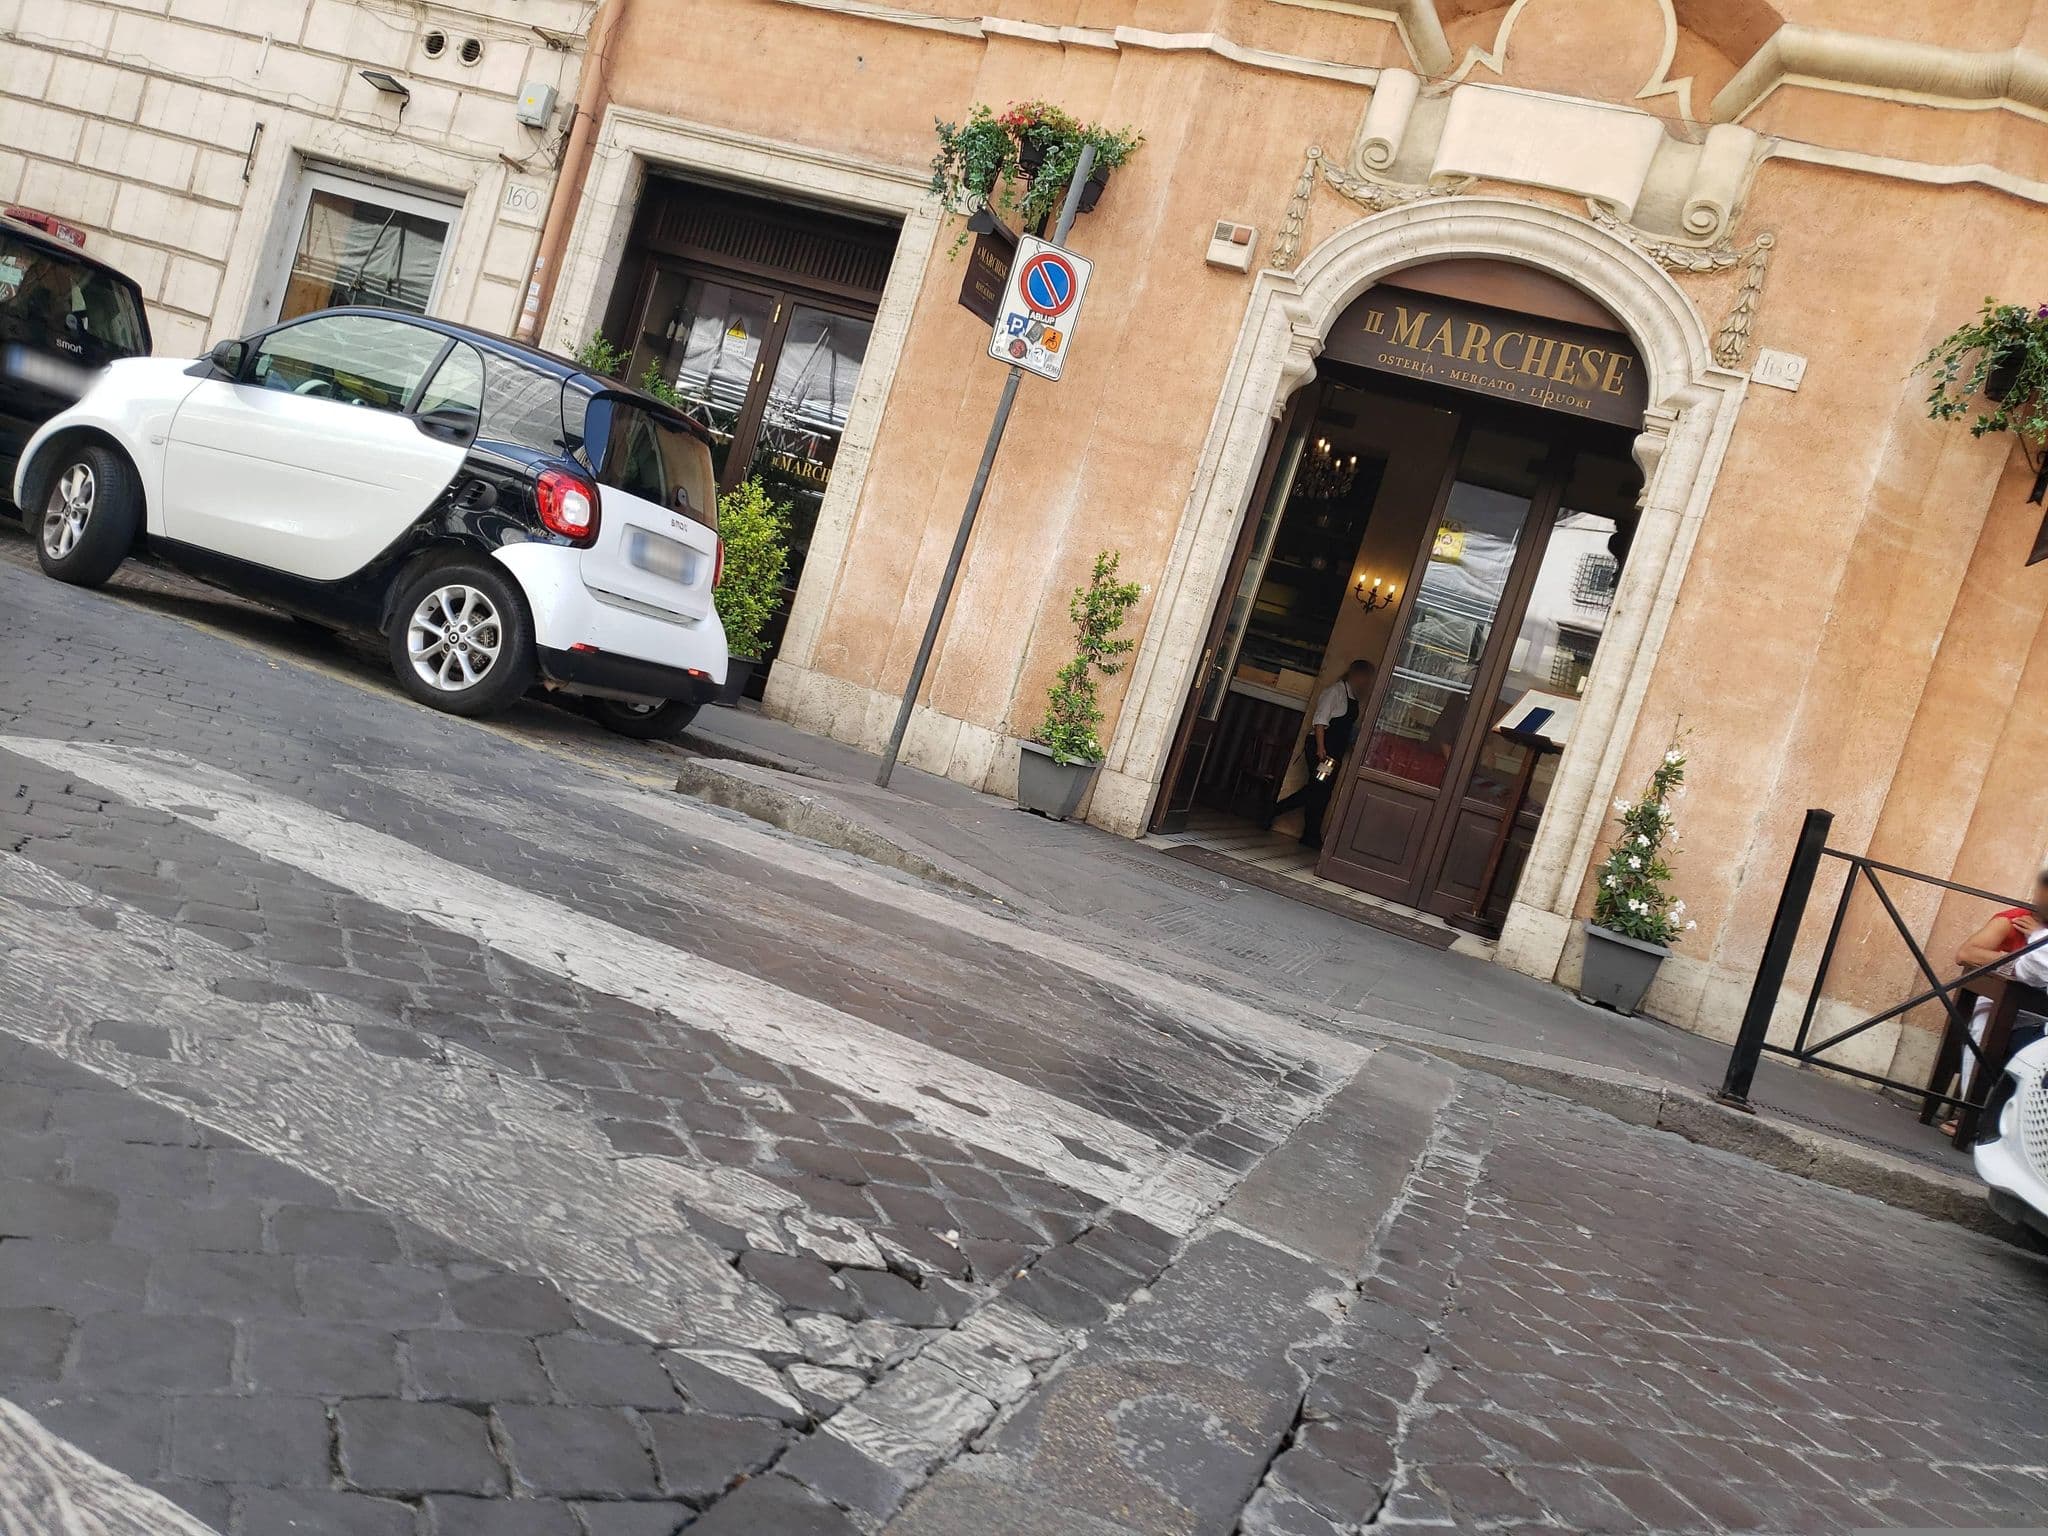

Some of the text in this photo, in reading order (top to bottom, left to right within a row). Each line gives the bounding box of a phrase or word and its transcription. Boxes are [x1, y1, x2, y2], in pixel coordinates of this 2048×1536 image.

[506, 186, 539, 210] 160
[56, 338, 83, 354] smart
[1361, 306, 1633, 396] IL MARCHESE
[1378, 353, 1592, 409] OSTERIA MERCATO LIQUORI
